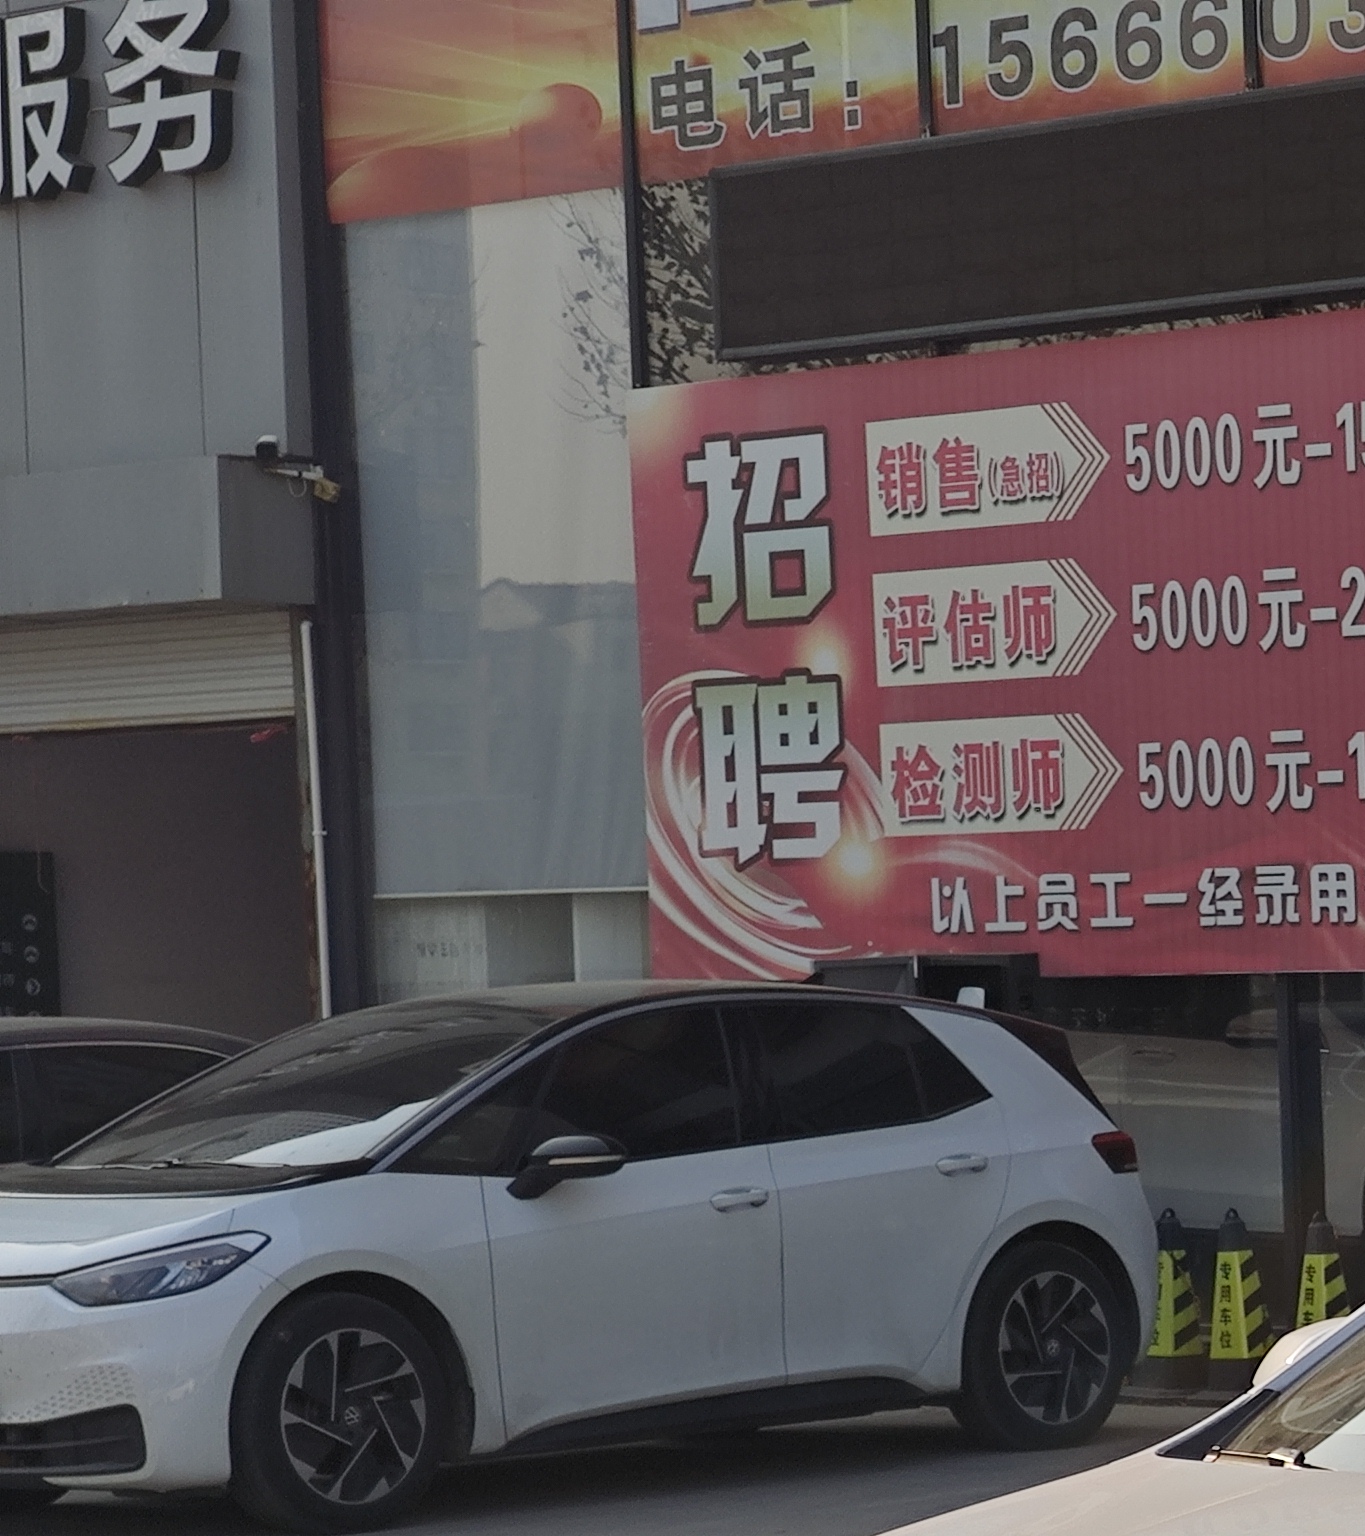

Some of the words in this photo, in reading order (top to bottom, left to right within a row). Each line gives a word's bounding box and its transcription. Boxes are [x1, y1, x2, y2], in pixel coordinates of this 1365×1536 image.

[683, 425, 847, 872] 招聘
[882, 584, 1057, 673] 评估师
[889, 738, 1065, 825] 检测师
[1218, 1261, 1233, 1349] 专用车位
